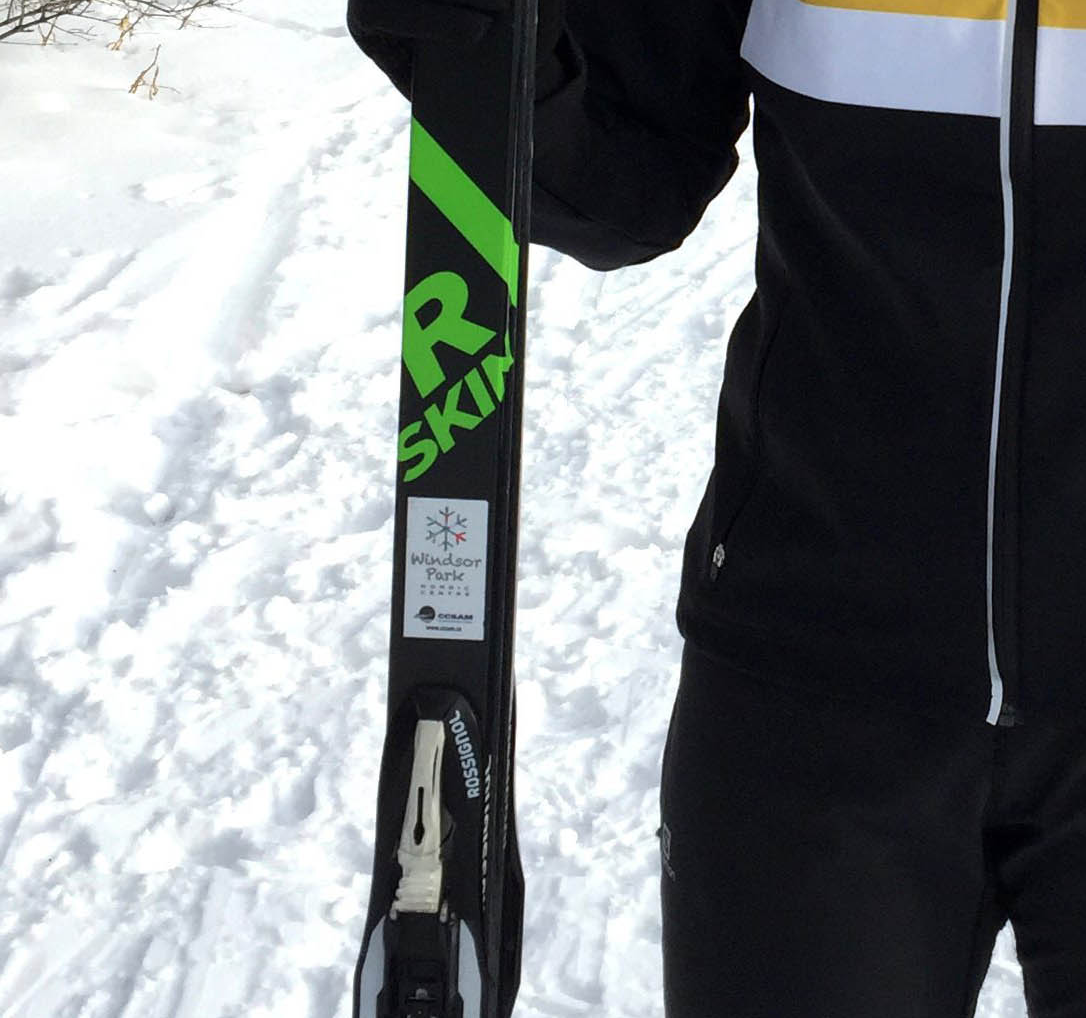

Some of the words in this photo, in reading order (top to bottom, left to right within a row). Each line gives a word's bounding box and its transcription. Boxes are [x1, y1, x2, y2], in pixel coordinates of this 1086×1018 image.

[402, 270, 498, 399] R
[411, 553, 482, 568] Windsor
[426, 567, 464, 582] Park
[449, 709, 480, 799] ROSSIGNOL
